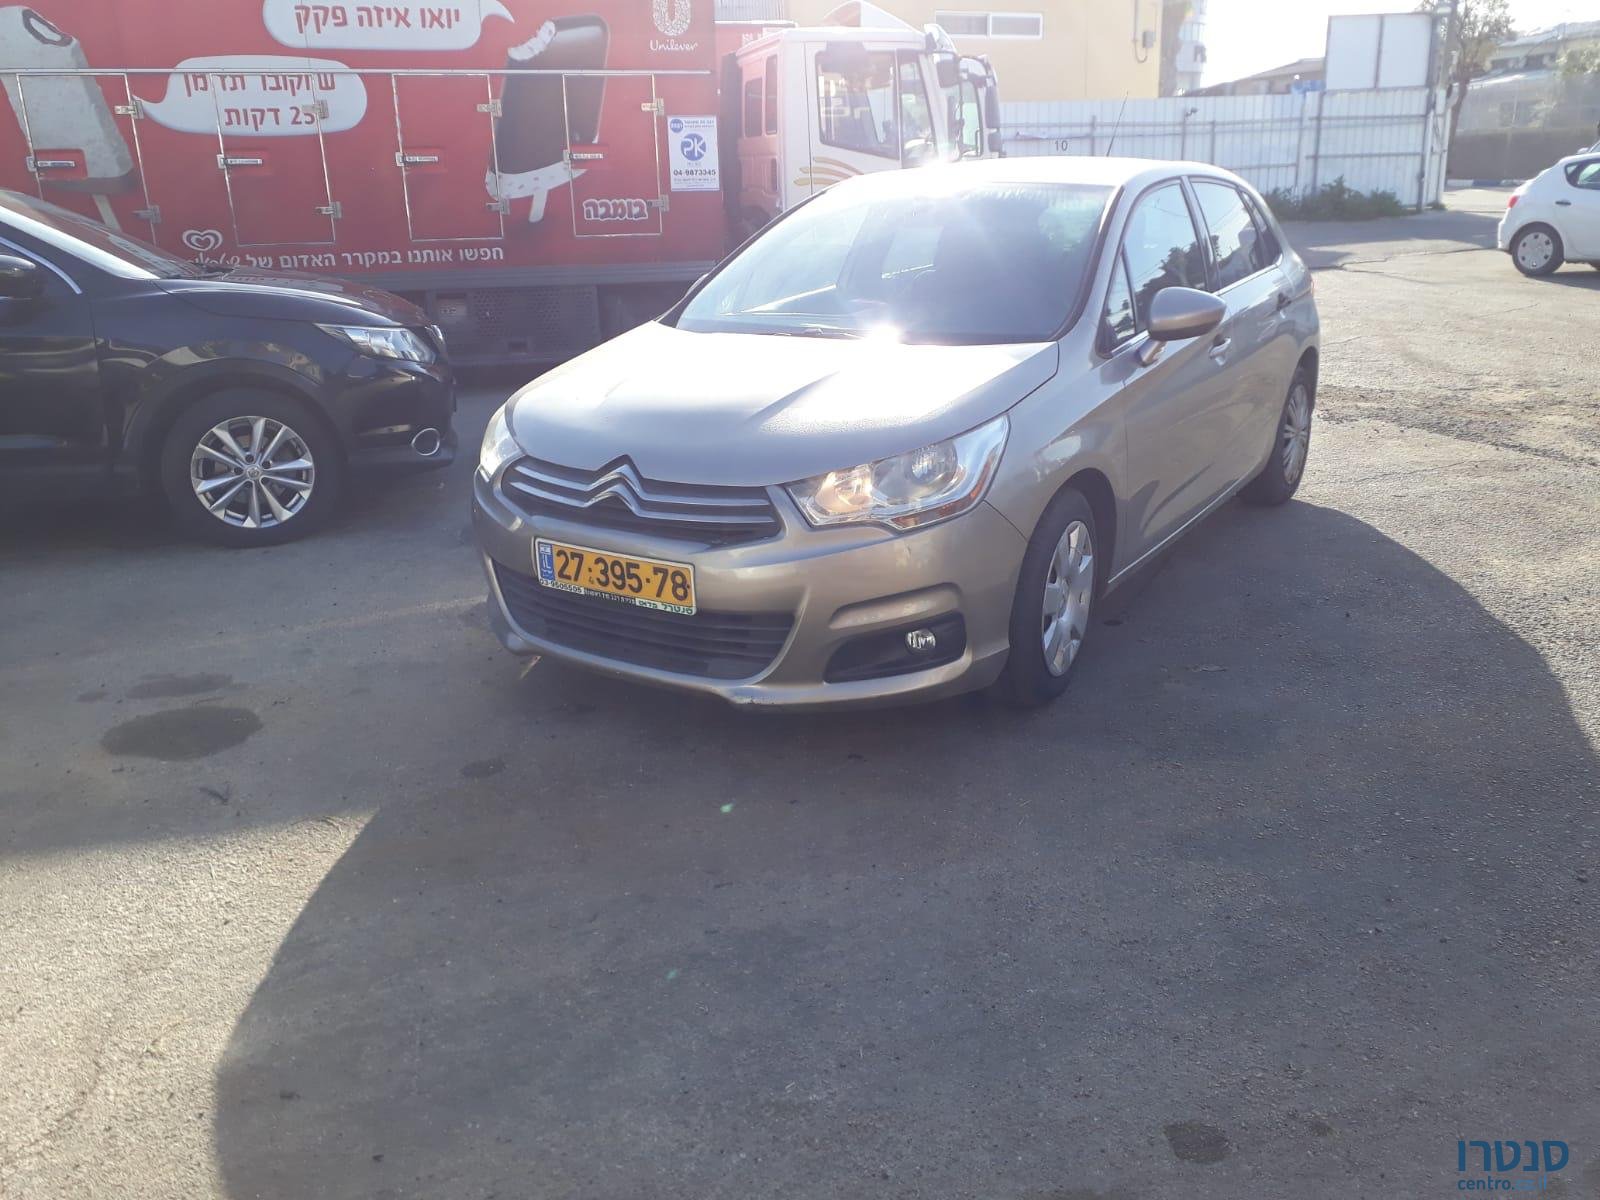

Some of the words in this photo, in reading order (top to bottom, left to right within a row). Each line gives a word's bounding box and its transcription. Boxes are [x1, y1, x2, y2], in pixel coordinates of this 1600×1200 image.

[294, 4, 348, 34] פקק
[356, 5, 411, 29] איזה
[419, 7, 460, 29] יואו
[649, 39, 698, 52] Unilever
[223, 107, 280, 131] דקות
[1054, 139, 1069, 152] 10
[583, 198, 648, 221] בומבה
[245, 254, 273, 269] של
[279, 253, 336, 269] האדום
[341, 251, 402, 268] במקרר
[407, 249, 453, 263] אותנו
[459, 247, 504, 262] חפשו
